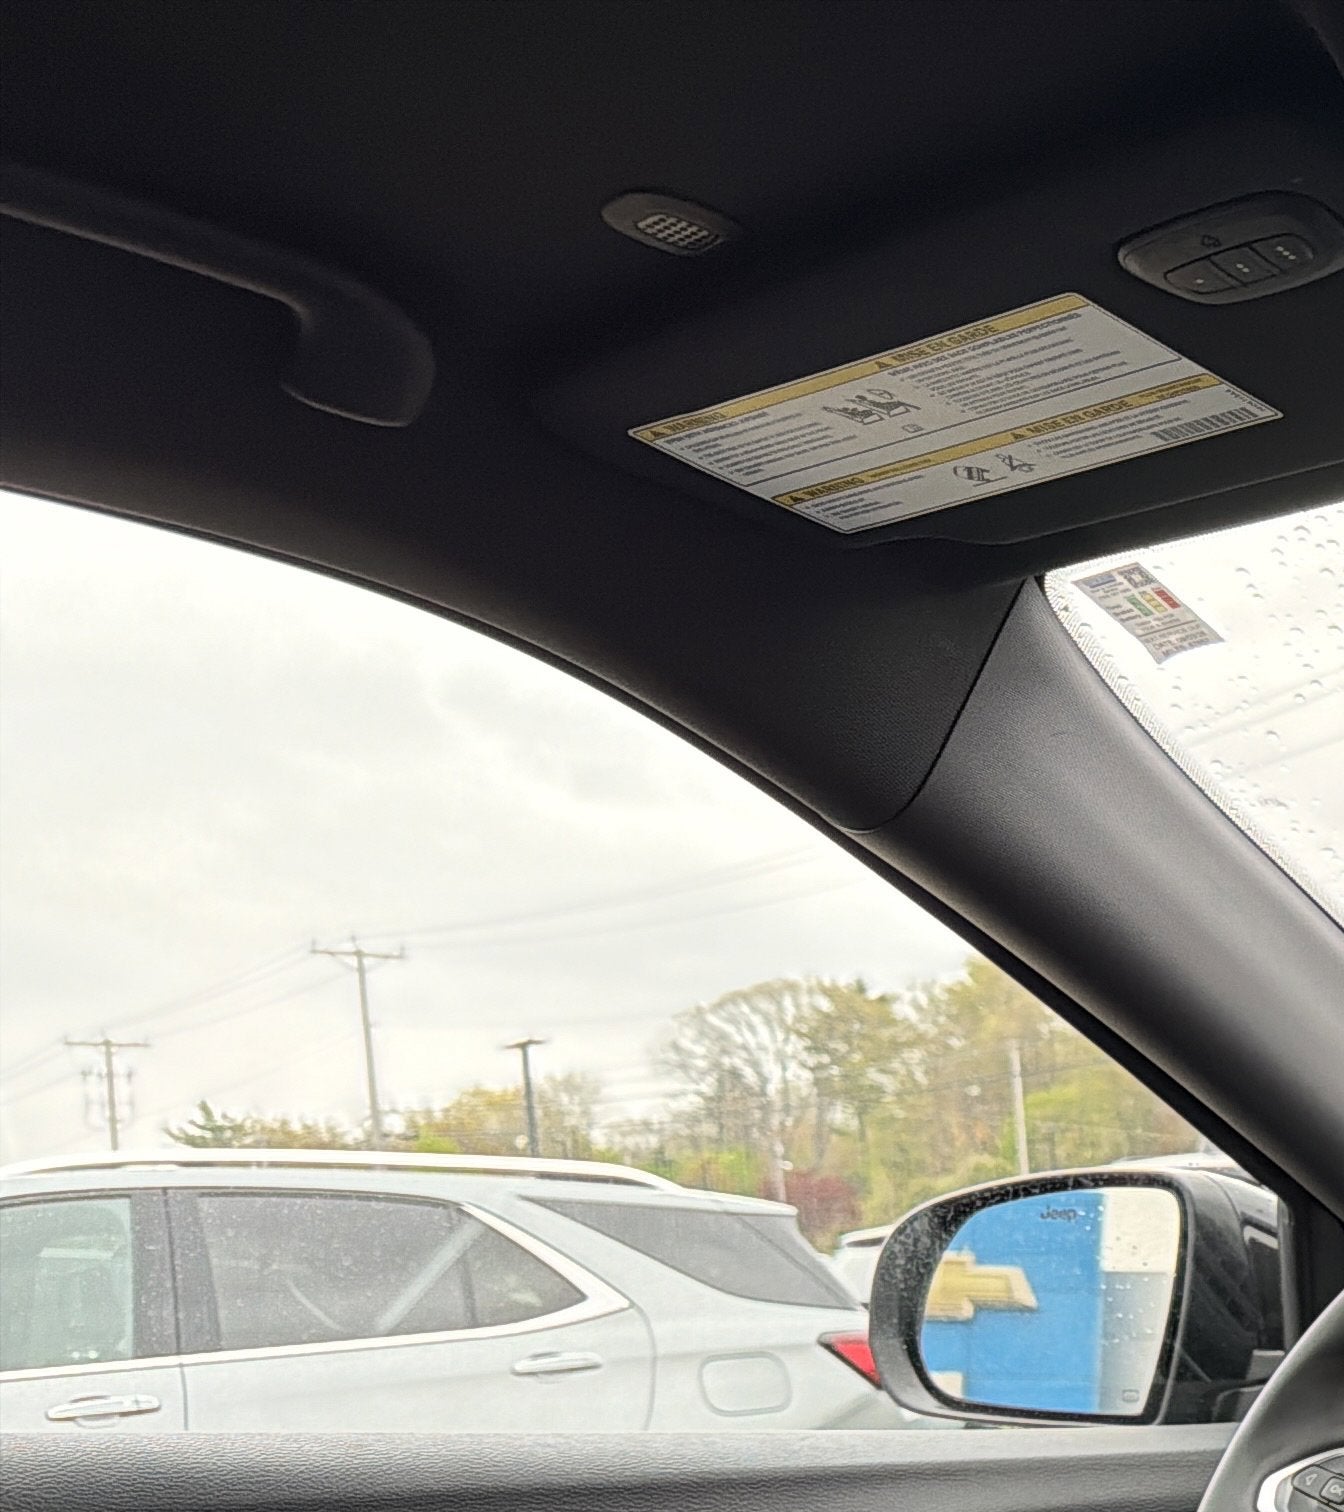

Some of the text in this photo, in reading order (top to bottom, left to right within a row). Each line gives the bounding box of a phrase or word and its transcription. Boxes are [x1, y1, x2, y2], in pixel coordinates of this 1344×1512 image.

[927, 340, 948, 353] EN
[948, 325, 999, 348] GARDE
[1026, 400, 1133, 435] MISE EN GARDE
[1040, 1205, 1077, 1223] Jeep
